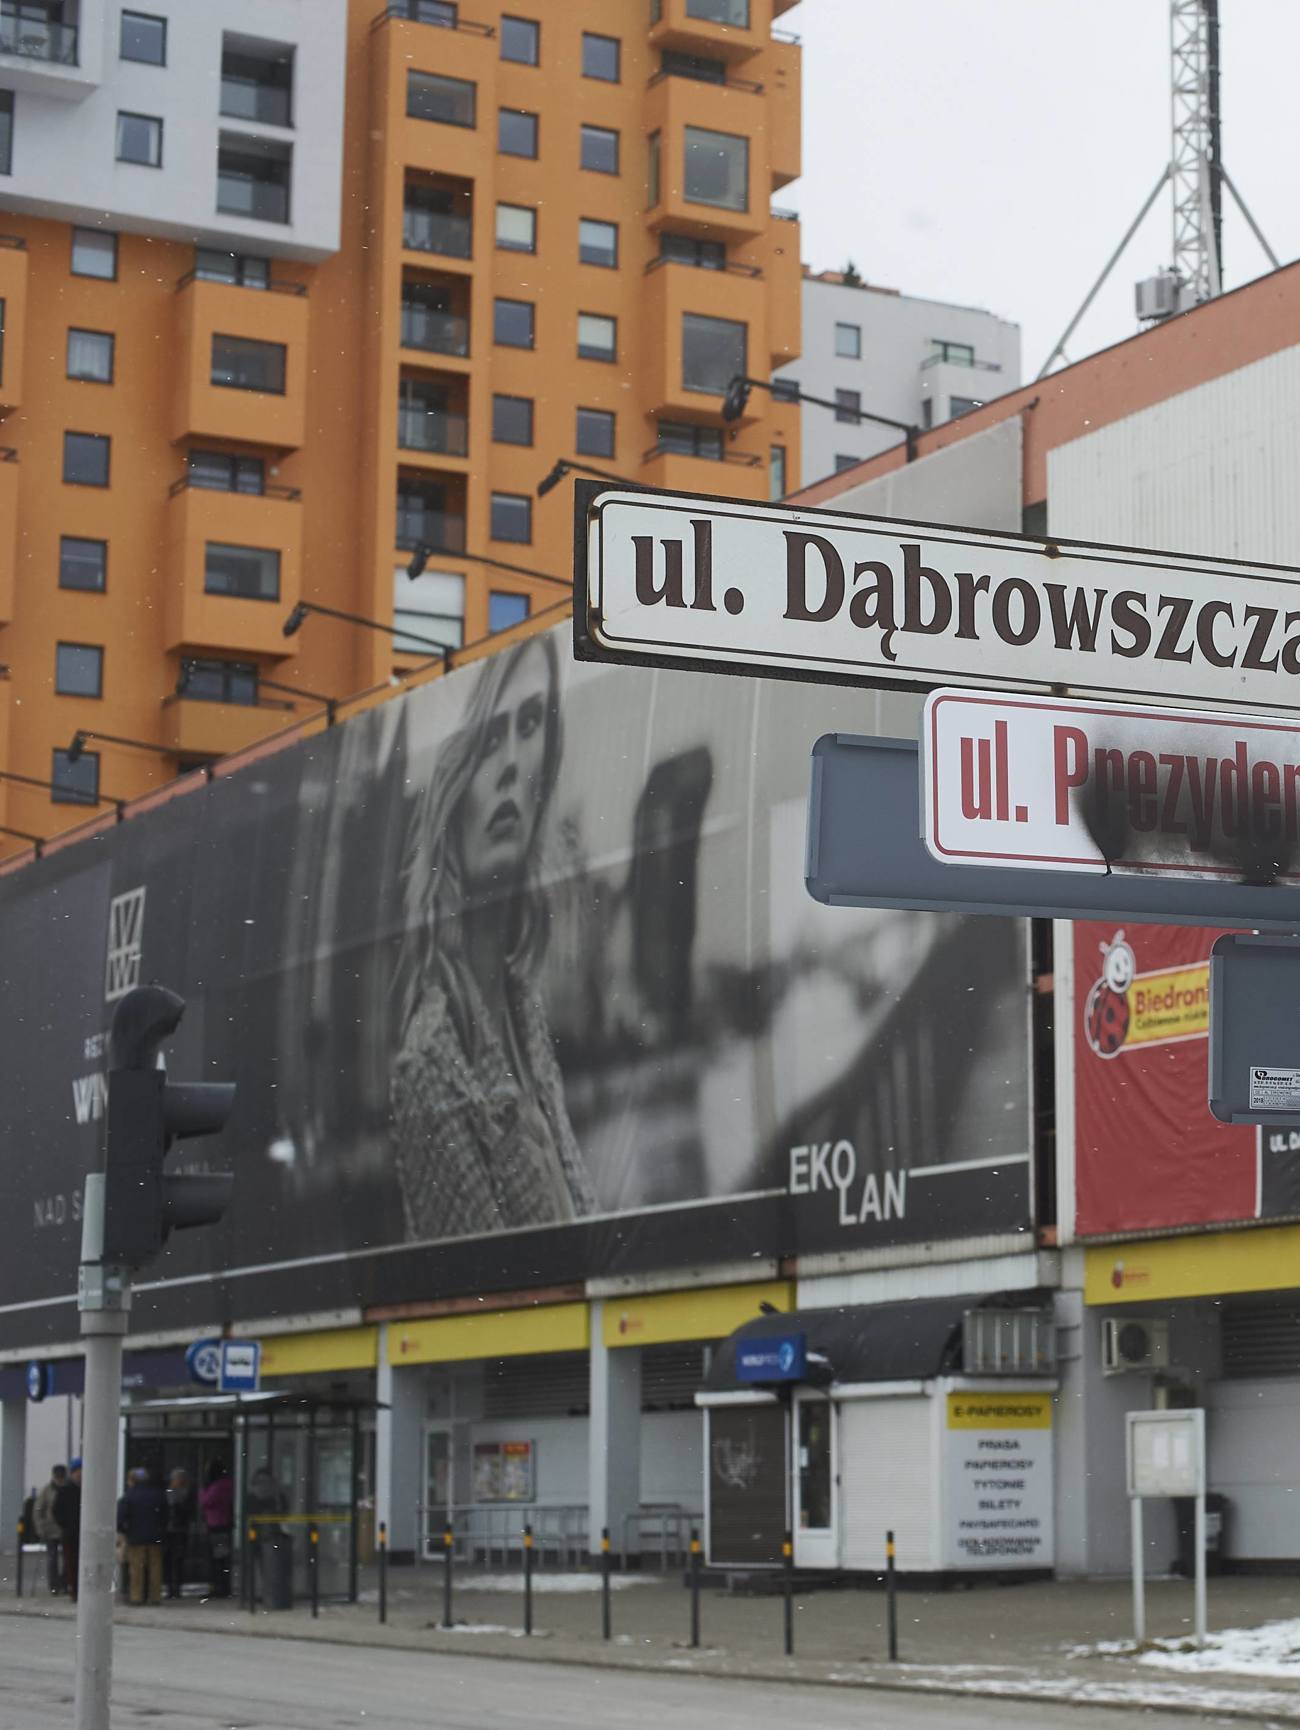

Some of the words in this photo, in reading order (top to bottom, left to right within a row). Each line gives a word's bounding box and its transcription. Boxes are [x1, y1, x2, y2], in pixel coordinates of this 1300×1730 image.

[631, 519, 746, 616] ul.
[960, 719, 1029, 823] ul.
[789, 1139, 857, 1195] EKO
[839, 1168, 907, 1226] LAN
